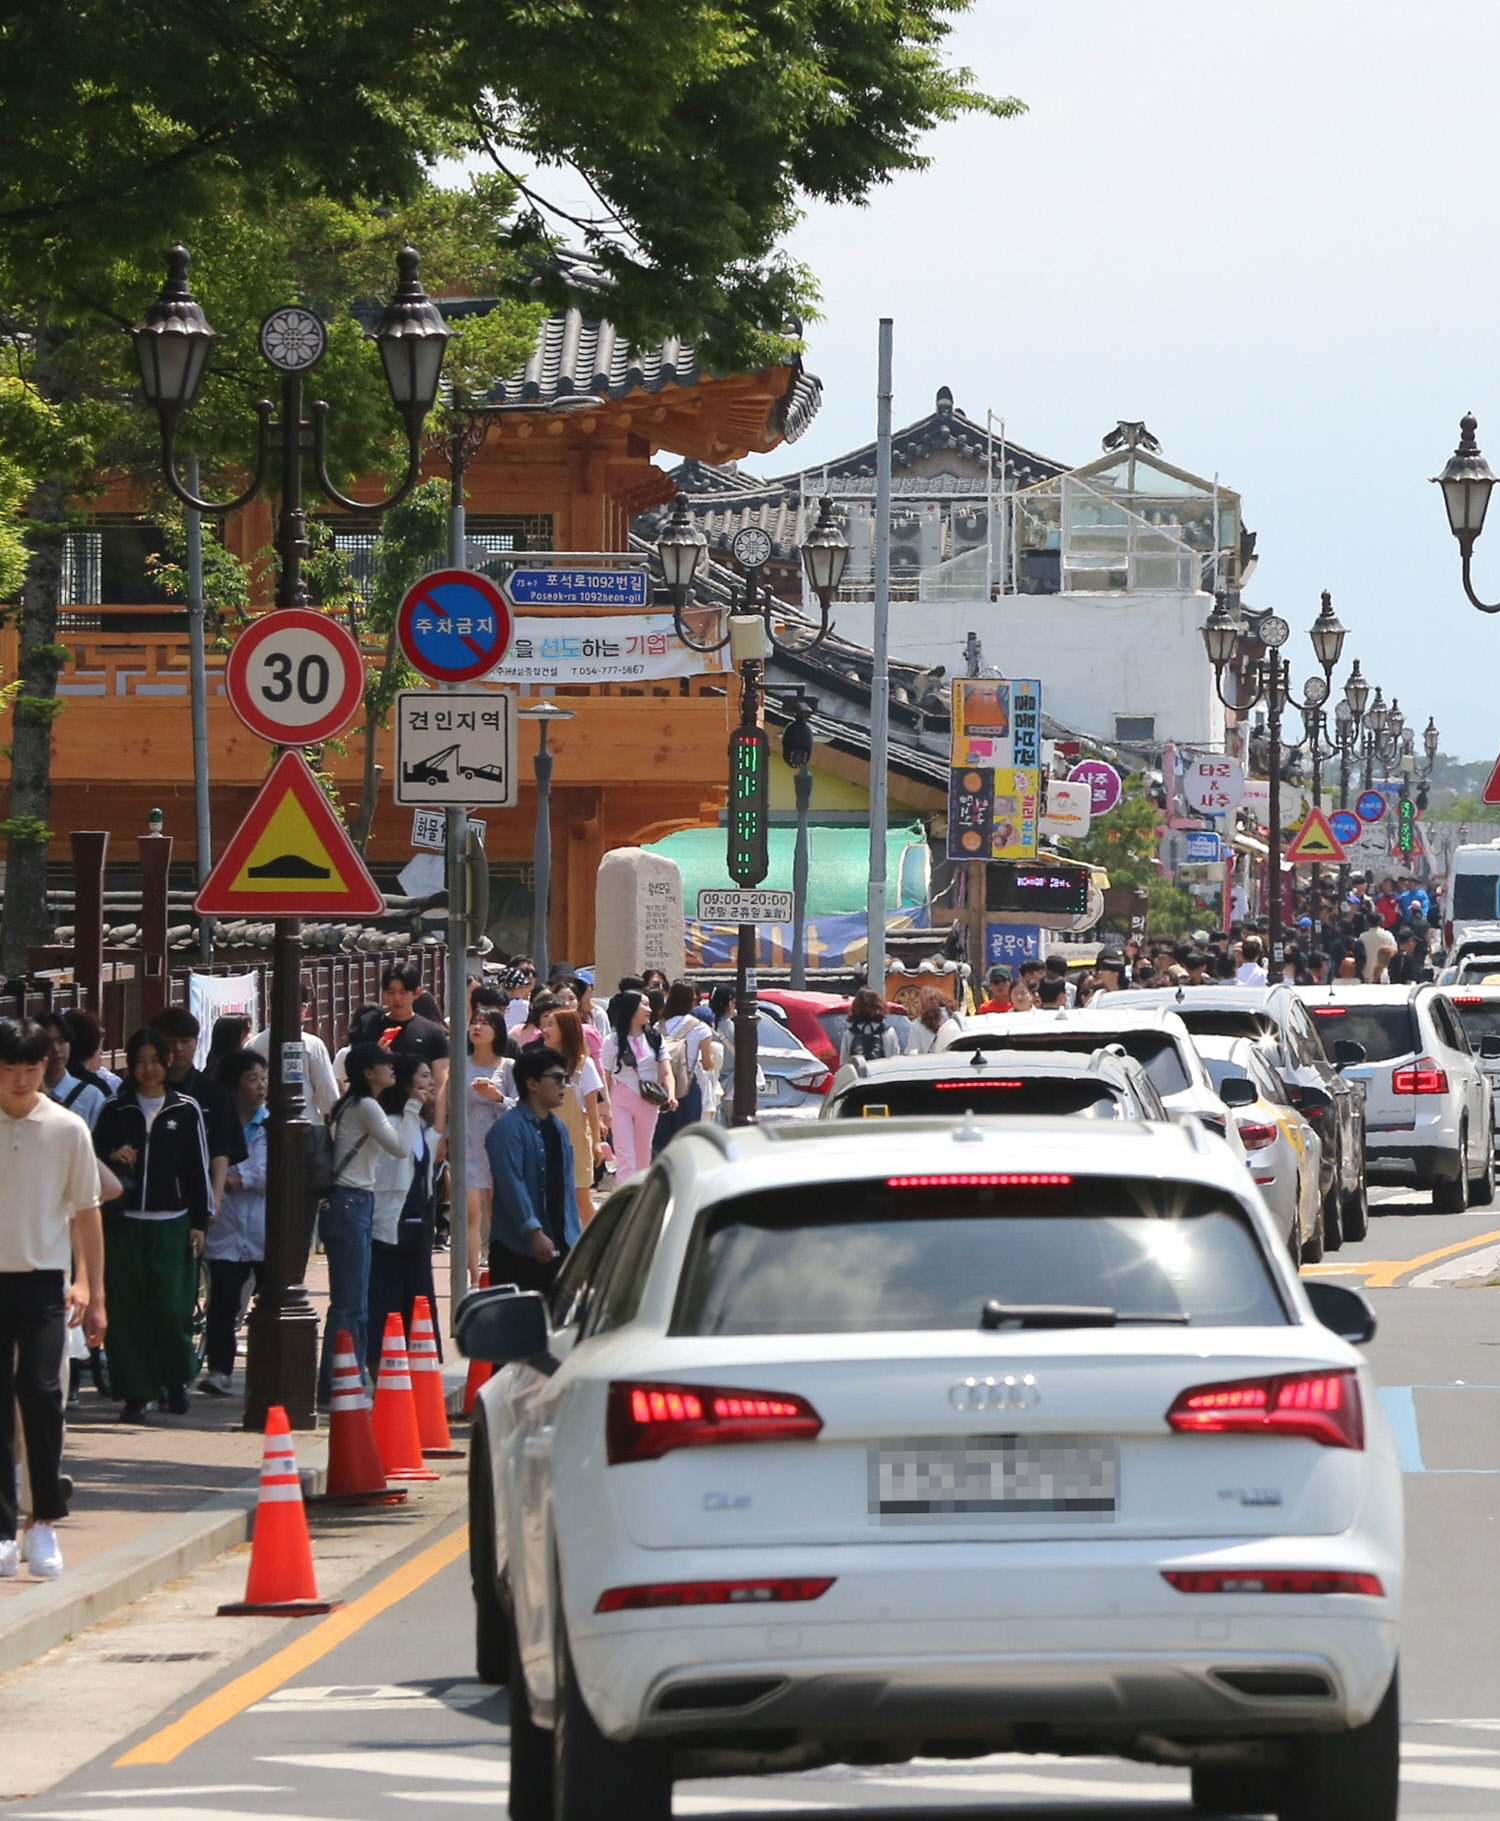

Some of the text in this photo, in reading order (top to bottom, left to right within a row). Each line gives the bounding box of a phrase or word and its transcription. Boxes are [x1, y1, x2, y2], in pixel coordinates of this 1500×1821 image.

[546, 574, 642, 591] 포석로1092번길
[530, 591, 577, 602] Poseok-ro
[414, 616, 494, 637] 주차금지
[539, 637, 620, 659] 선도하는
[626, 633, 668, 656] 기업
[261, 653, 330, 704] 30
[408, 710, 501, 732] 견인지역
[1199, 763, 1231, 778] 타로
[1210, 780, 1219, 790] &
[1200, 793, 1231, 807] 사주
[703, 893, 788, 906] 09:00~20:00
[990, 934, 1037, 957] 골목안
